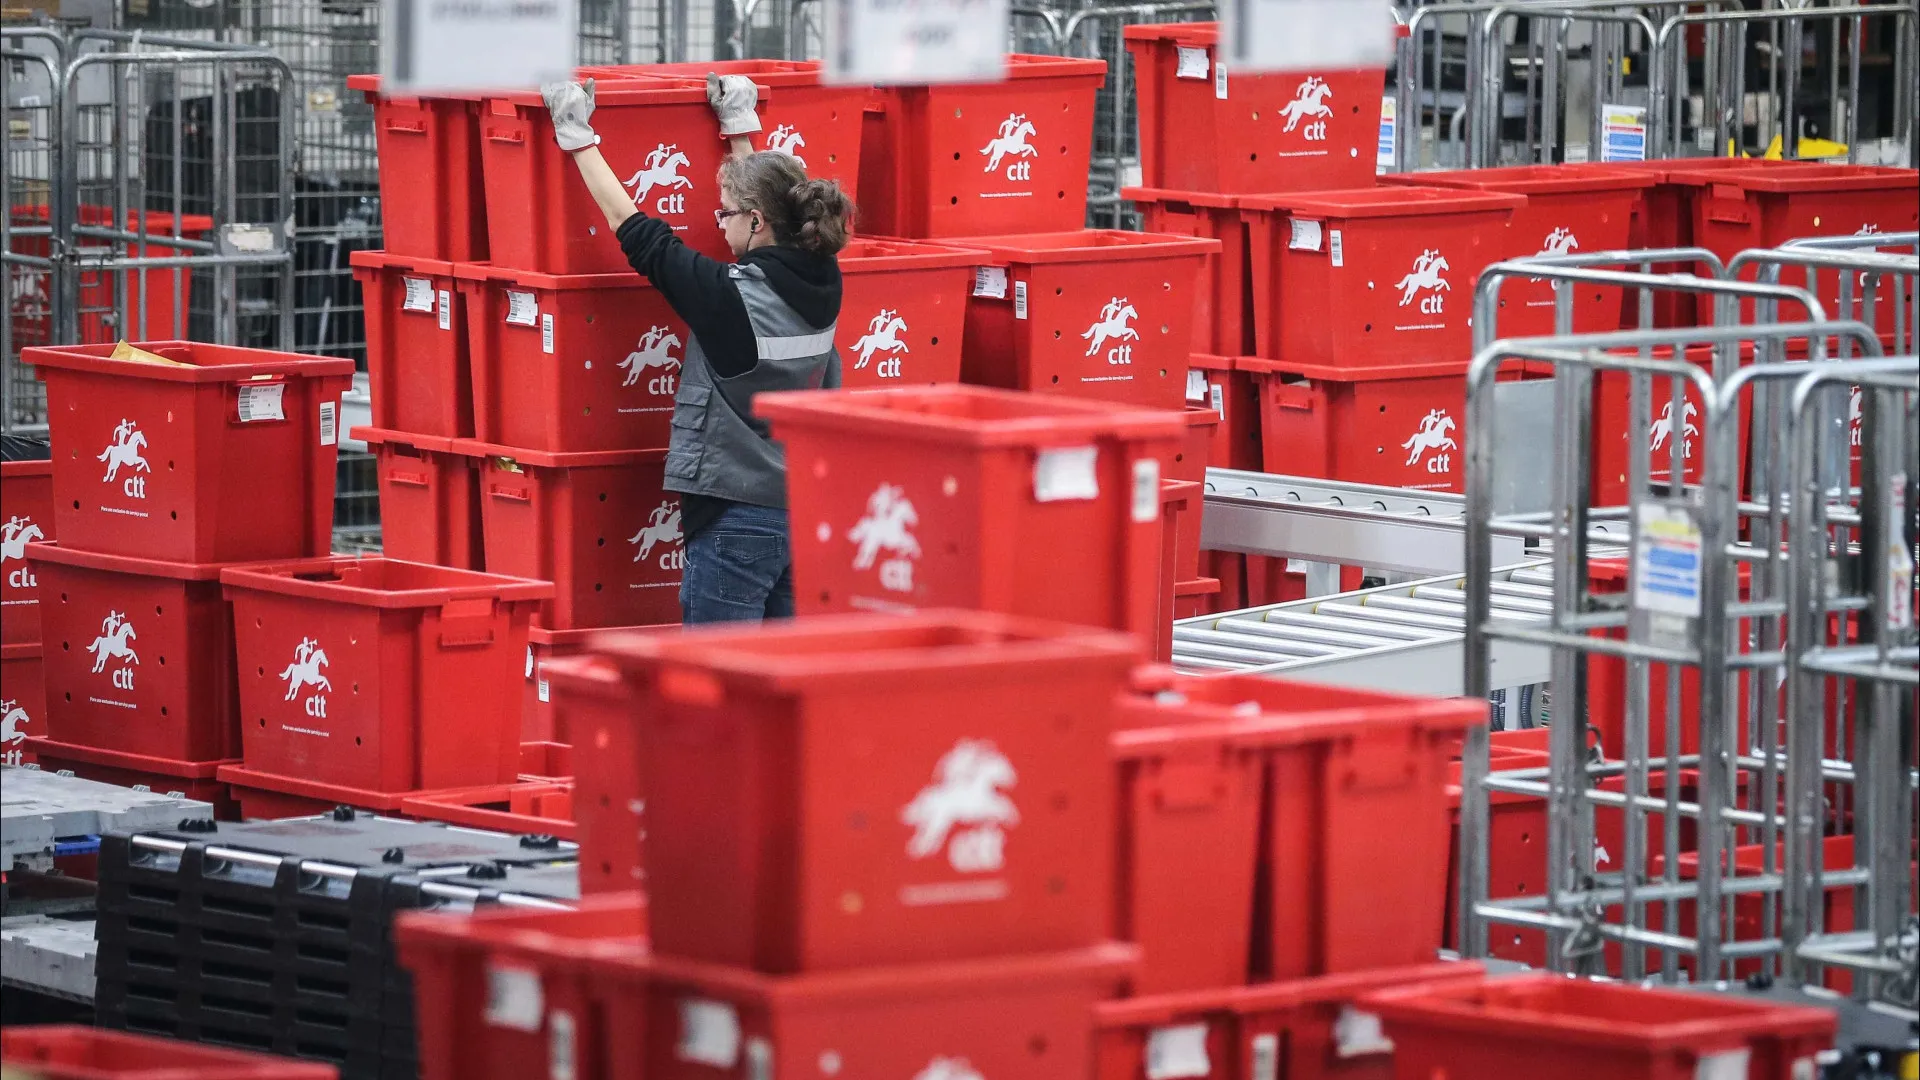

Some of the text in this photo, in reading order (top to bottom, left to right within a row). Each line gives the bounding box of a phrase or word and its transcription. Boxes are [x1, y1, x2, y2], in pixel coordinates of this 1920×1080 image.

[1304, 121, 1326, 140] ctt
[1006, 161, 1030, 181] ctt
[656, 193, 685, 215] ctt
[1420, 294, 1443, 314] ctt
[1108, 345, 1132, 365] ctt
[877, 357, 901, 377] ctt
[648, 374, 675, 395] ctt
[1427, 454, 1450, 473] ctt
[124, 475, 145, 498] ctt
[112, 667, 134, 690] ctt
[305, 694, 327, 718] ctt
